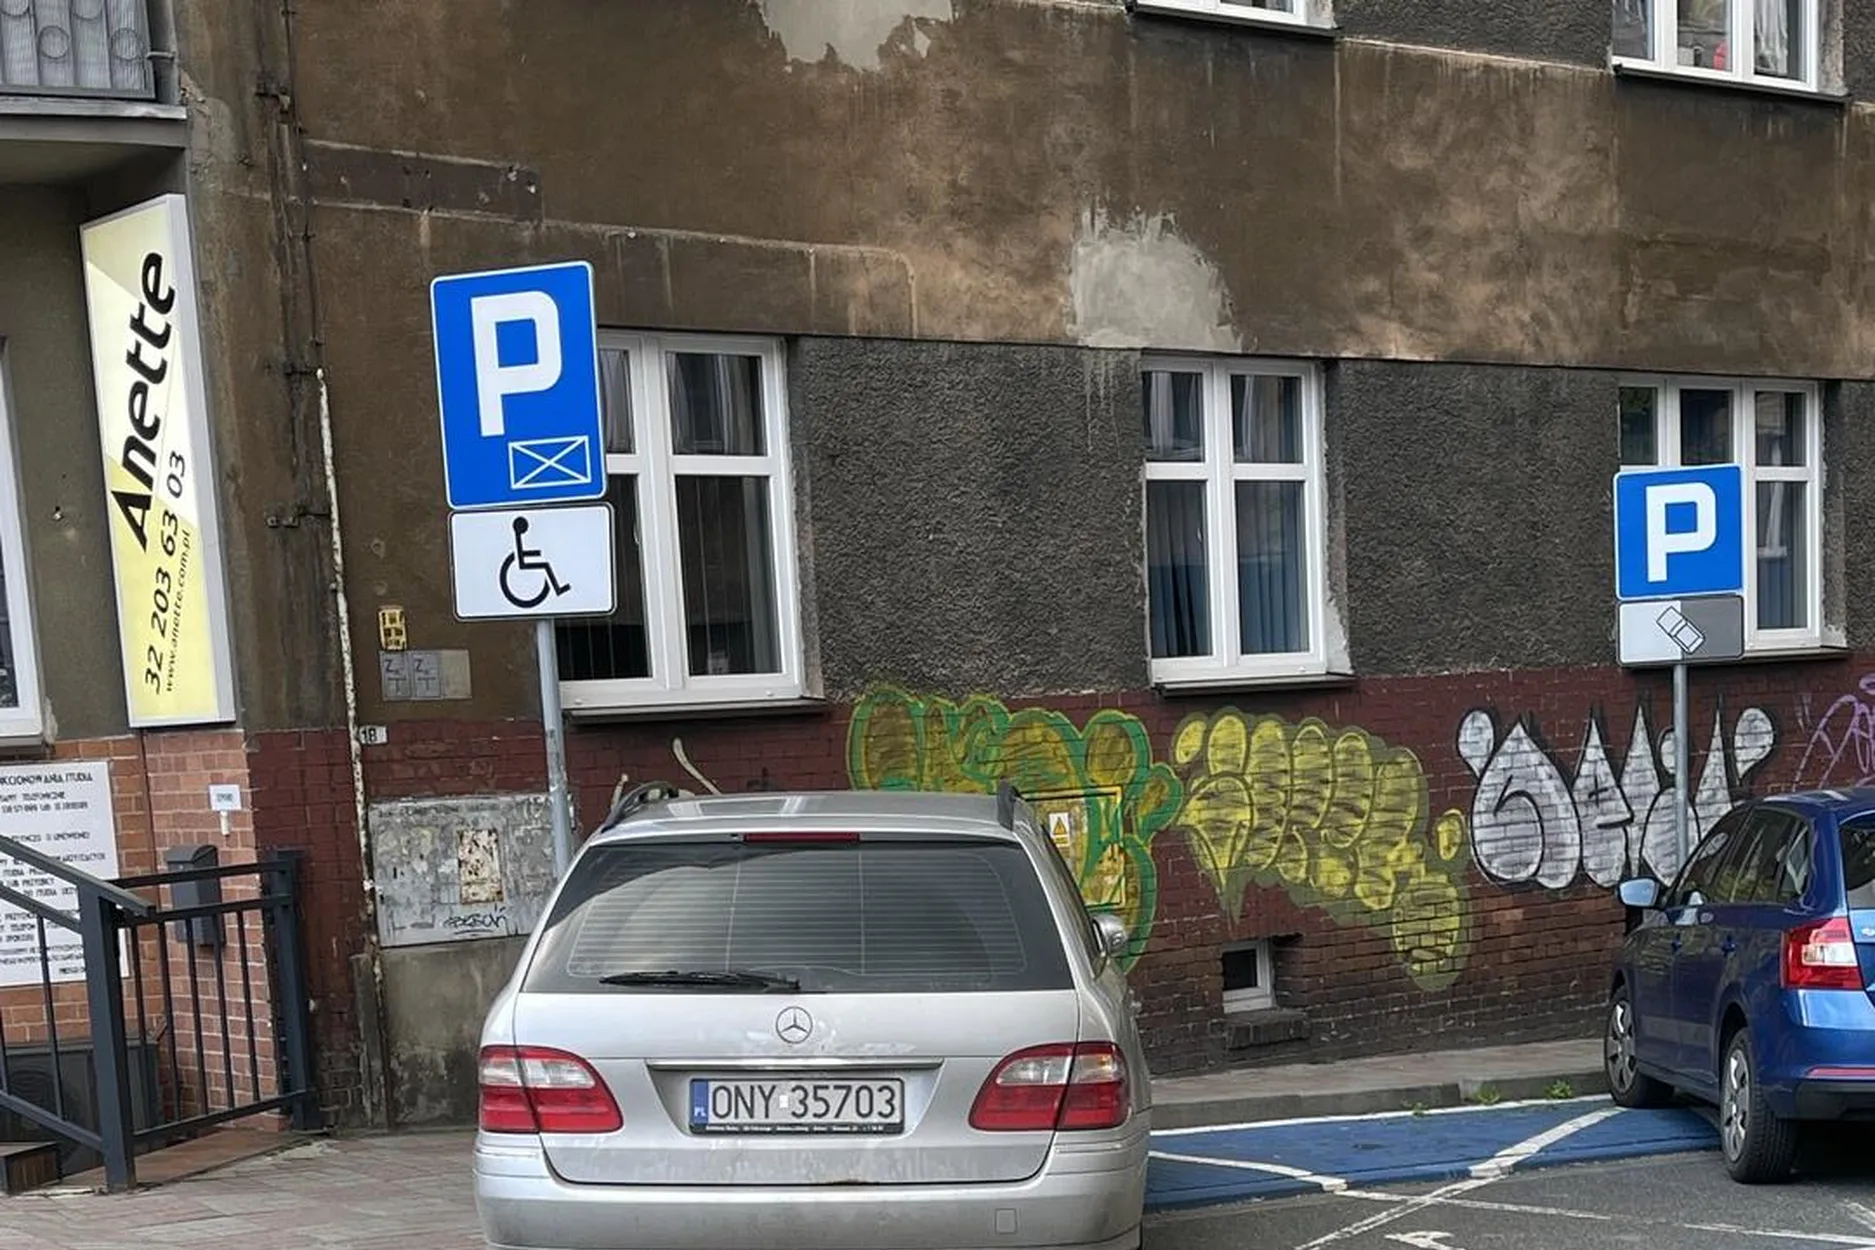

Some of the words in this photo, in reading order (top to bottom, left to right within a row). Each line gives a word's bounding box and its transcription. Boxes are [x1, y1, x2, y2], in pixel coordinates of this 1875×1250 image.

[471, 290, 563, 437] P
[111, 252, 176, 554] Anette
[166, 451, 186, 499] 03
[160, 509, 179, 557] 63
[1646, 482, 1717, 582] P
[152, 567, 171, 638] 203
[166, 529, 191, 692] www.anette.com.pl
[145, 645, 163, 694] 32
[694, 1107, 706, 1117] PL
[712, 1085, 776, 1119] ONY
[791, 1085, 896, 1119] 35703
